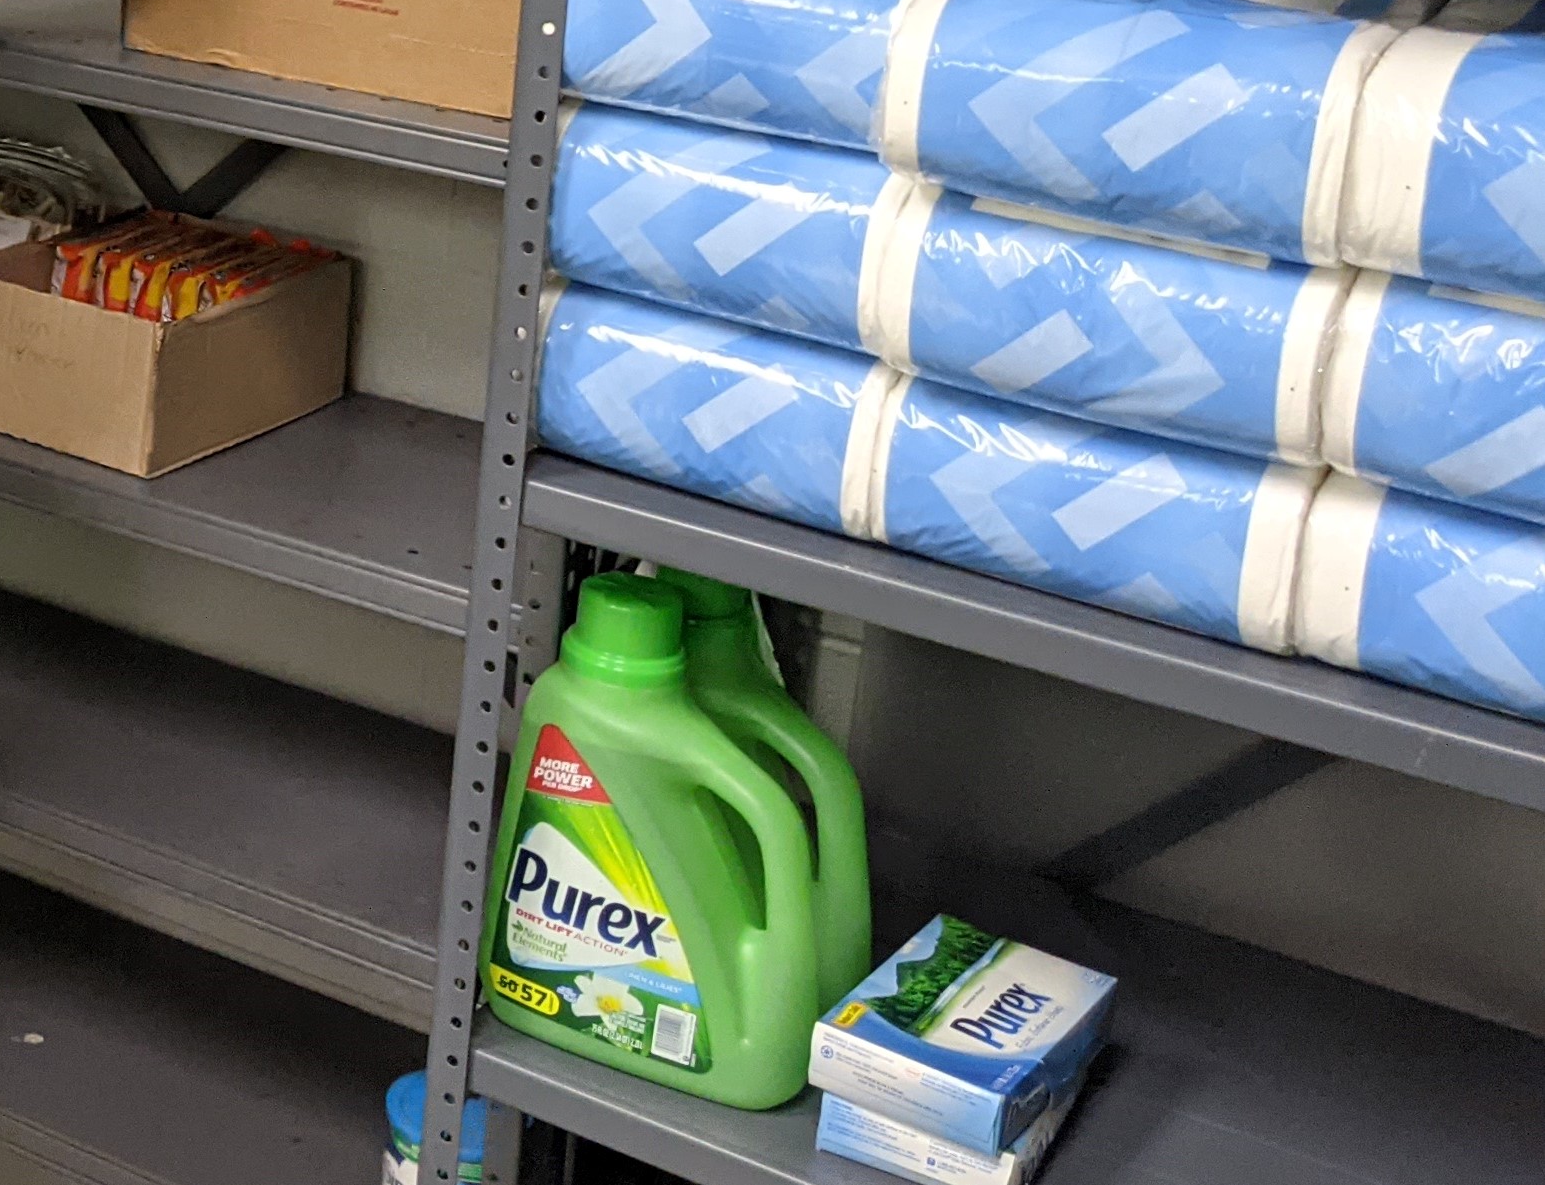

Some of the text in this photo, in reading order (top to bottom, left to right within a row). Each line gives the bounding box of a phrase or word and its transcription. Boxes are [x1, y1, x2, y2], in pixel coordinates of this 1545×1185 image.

[533, 766, 593, 789] POWER
[539, 756, 580, 773] MORE
[508, 847, 666, 958] Purex
[515, 907, 626, 956] DIRT LIFT ACTION
[523, 927, 568, 952] Natural
[512, 932, 566, 963] Elements
[519, 984, 548, 1008] 57
[950, 982, 1053, 1050] Purex
